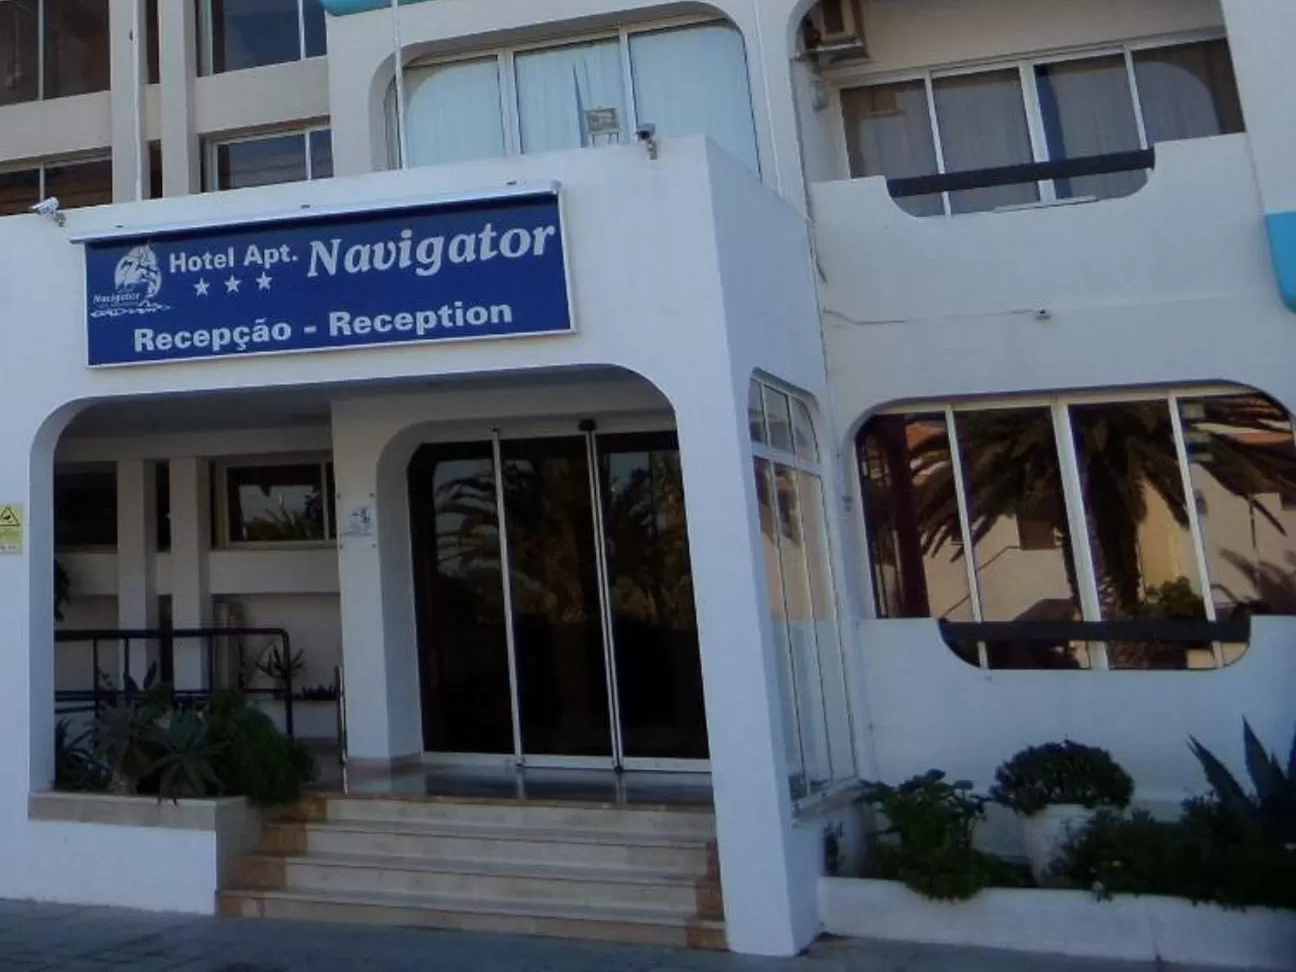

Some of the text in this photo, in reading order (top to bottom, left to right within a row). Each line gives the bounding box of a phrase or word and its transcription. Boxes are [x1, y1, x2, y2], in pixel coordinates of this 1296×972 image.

[169, 224, 555, 277] Hotel Apt. Navigator
[134, 318, 292, 351] Recepção
[329, 301, 512, 336] Reception
